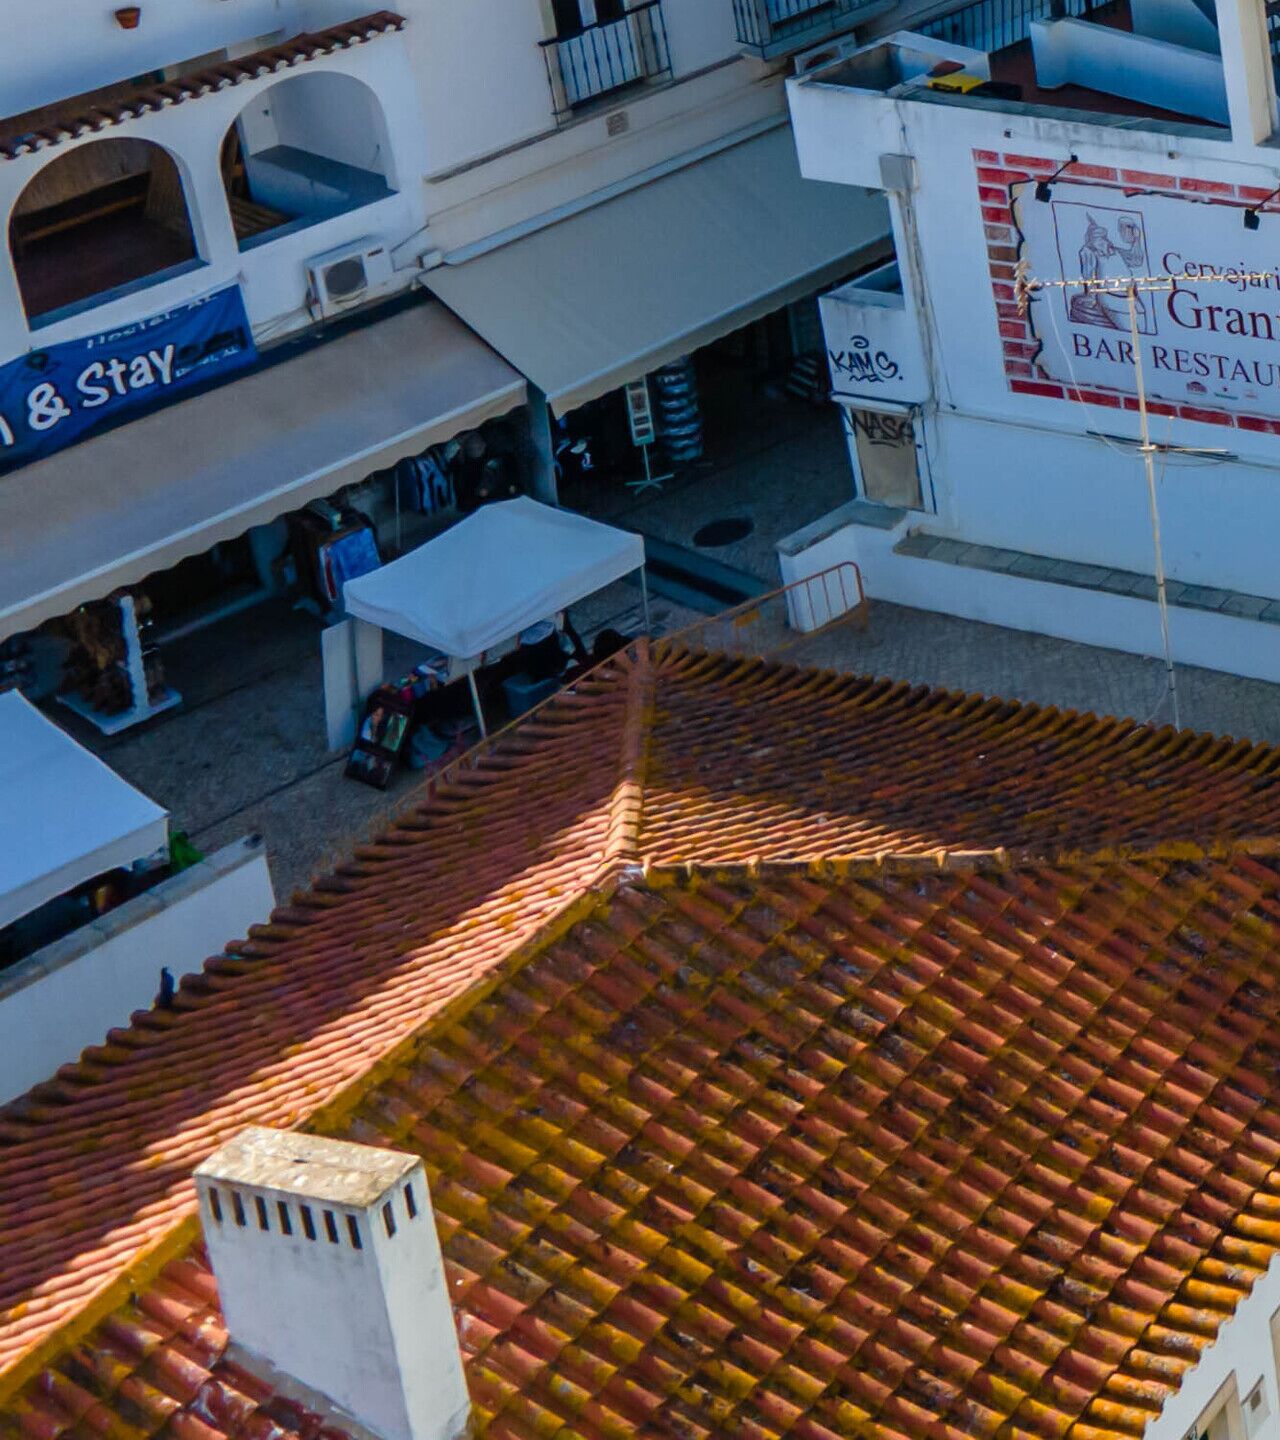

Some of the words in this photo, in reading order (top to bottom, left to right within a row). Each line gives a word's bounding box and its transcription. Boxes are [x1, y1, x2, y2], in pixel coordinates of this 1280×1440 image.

[1072, 332, 1136, 365] BAR
[26, 383, 70, 431] &
[76, 344, 175, 408] Stay
